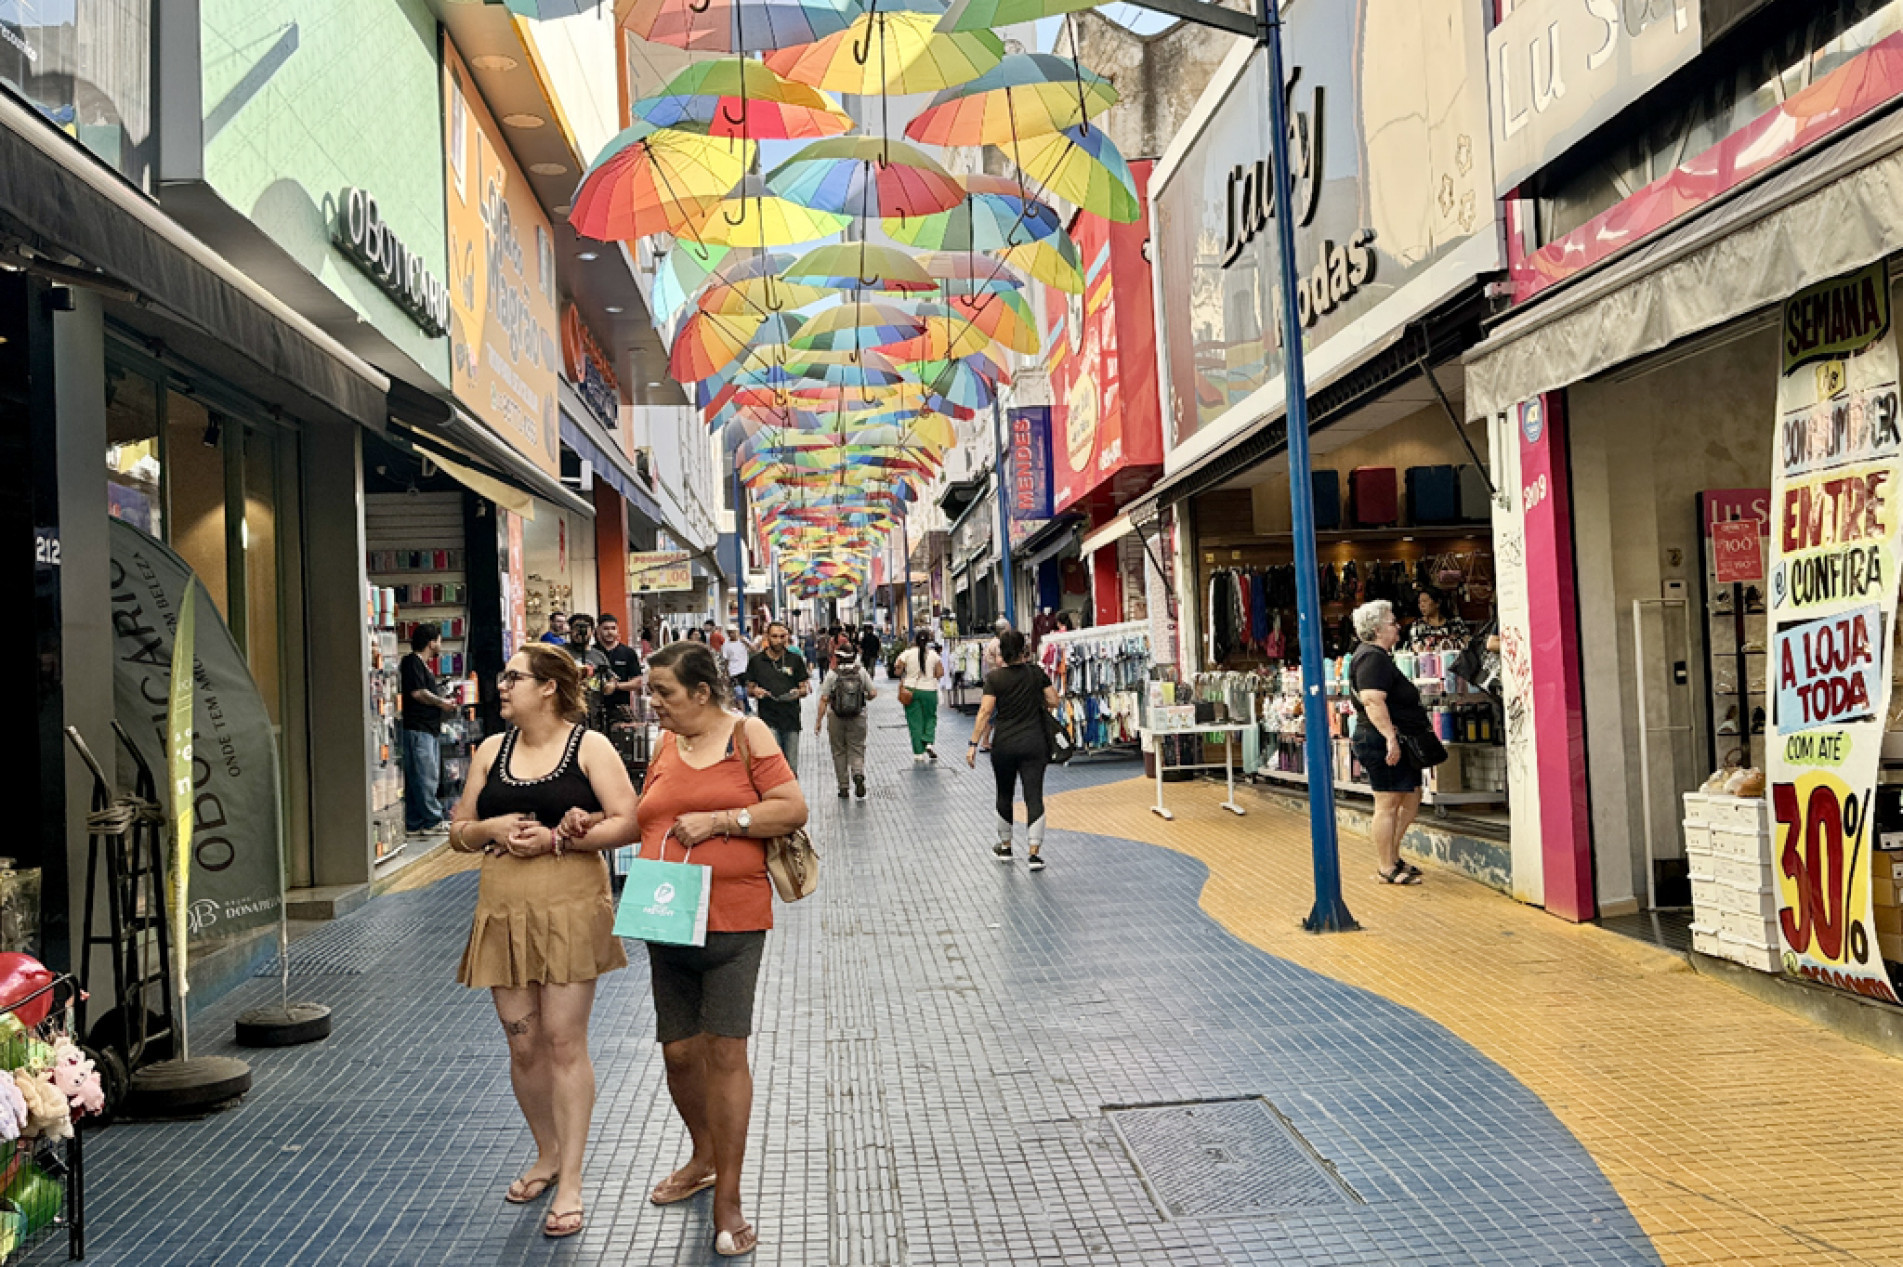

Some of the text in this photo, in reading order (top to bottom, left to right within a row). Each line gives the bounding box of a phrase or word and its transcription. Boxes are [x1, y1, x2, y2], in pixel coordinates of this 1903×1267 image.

[1501, 20, 1565, 141] Lu
[1272, 227, 1378, 347] odas
[1788, 276, 1881, 357] SEMANA
[1012, 417, 1035, 510] MENDES
[1782, 469, 1891, 553] ENTRE
[36, 535, 61, 565] 212
[133, 551, 170, 609] BELEZA
[1791, 544, 1884, 607] CONFIRA
[1781, 614, 1873, 691] A LOJA
[204, 696, 226, 732] TEM
[1797, 671, 1870, 723] TODA
[218, 735, 241, 778] ONDE
[1787, 729, 1844, 761] COM ATÉ
[1772, 781, 1871, 964] 30%
